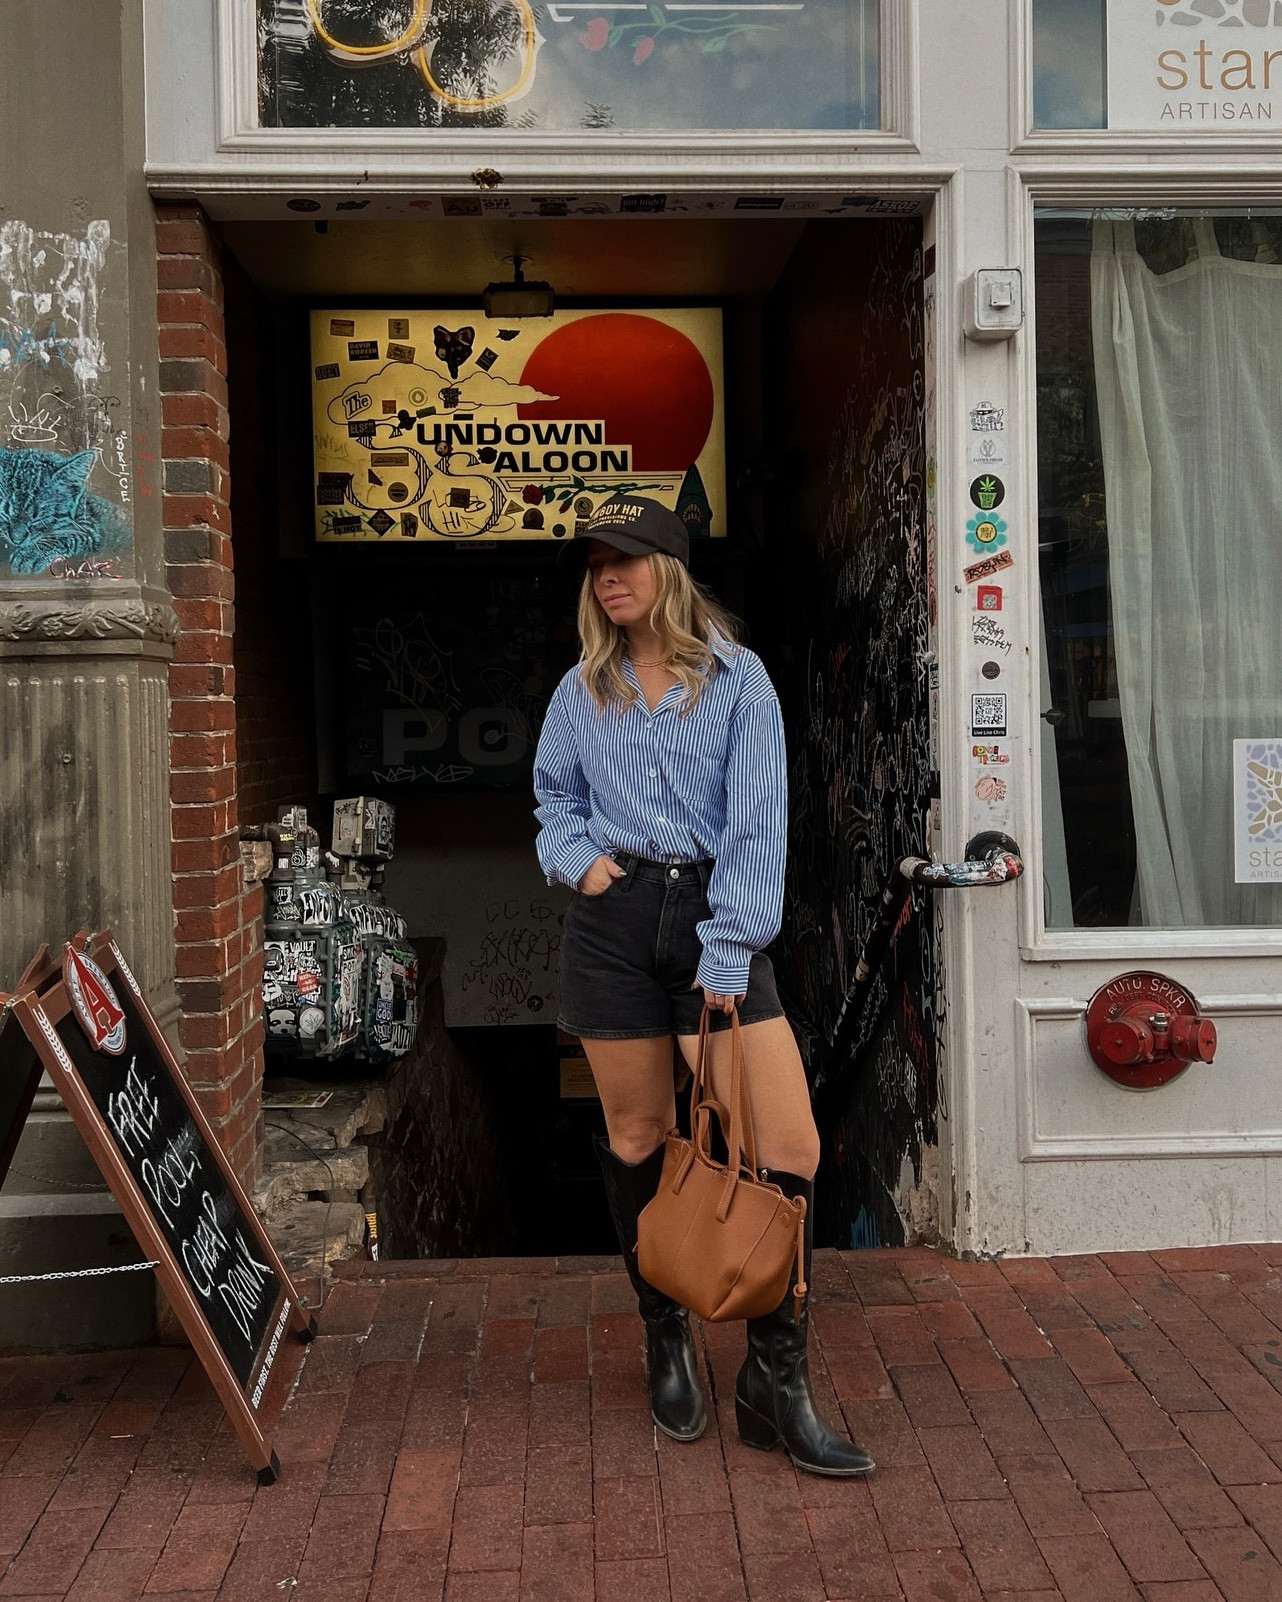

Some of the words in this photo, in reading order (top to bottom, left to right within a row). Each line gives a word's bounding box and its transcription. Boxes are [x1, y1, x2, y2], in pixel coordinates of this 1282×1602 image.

[1160, 102, 1272, 120] ARTISAN
[345, 391, 370, 416] The
[622, 503, 645, 518] HAT
[377, 1008, 393, 1020] GOD
[107, 1055, 162, 1158] FREE
[181, 1190, 231, 1299] CHEAP
[218, 1228, 274, 1352] DRINK
[274, 1320, 285, 1341] WILL
[269, 1334, 280, 1357] REST
[264, 1350, 275, 1369] THE
[251, 1384, 263, 1410] BEER
